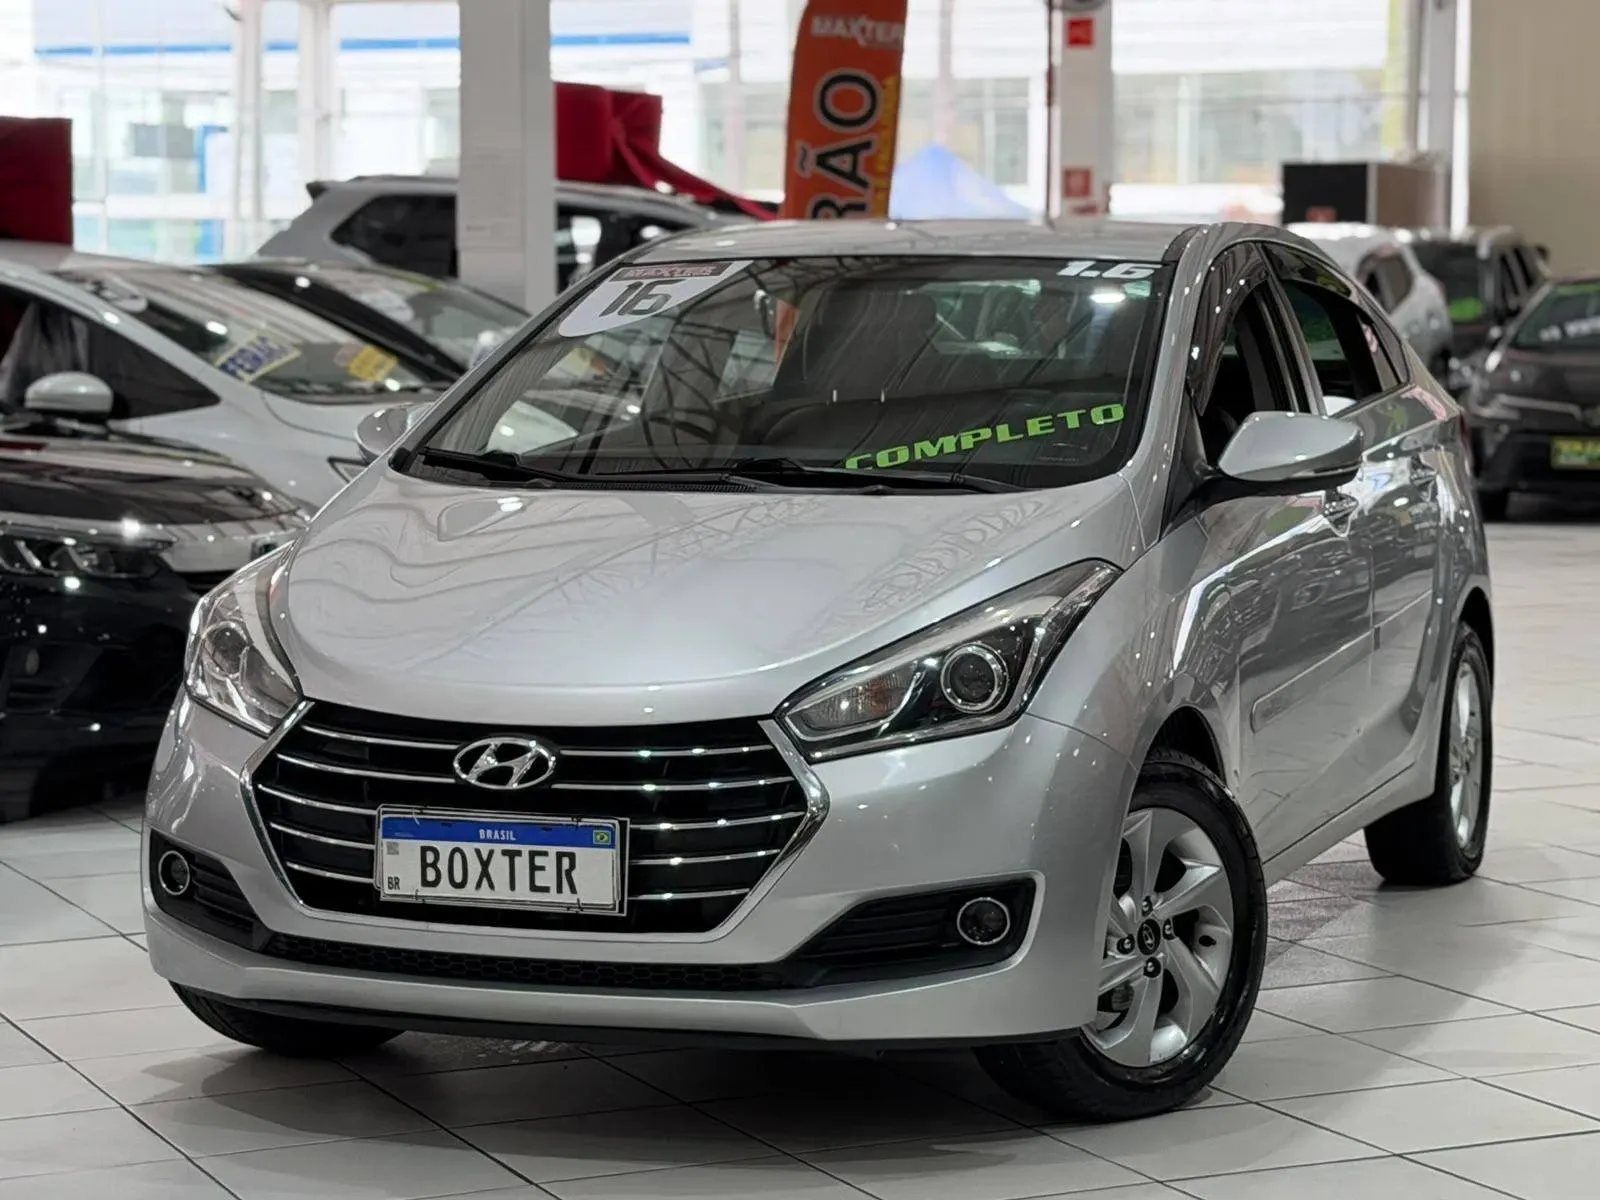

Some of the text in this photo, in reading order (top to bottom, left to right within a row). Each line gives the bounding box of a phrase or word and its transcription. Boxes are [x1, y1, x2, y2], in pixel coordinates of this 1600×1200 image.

[1056, 260, 1162, 280] 1.6
[599, 279, 686, 317] 16
[844, 403, 1125, 471] COMPLETO
[479, 828, 517, 842] BRASIL
[386, 876, 401, 891] BR
[419, 844, 579, 895] BOXTER
